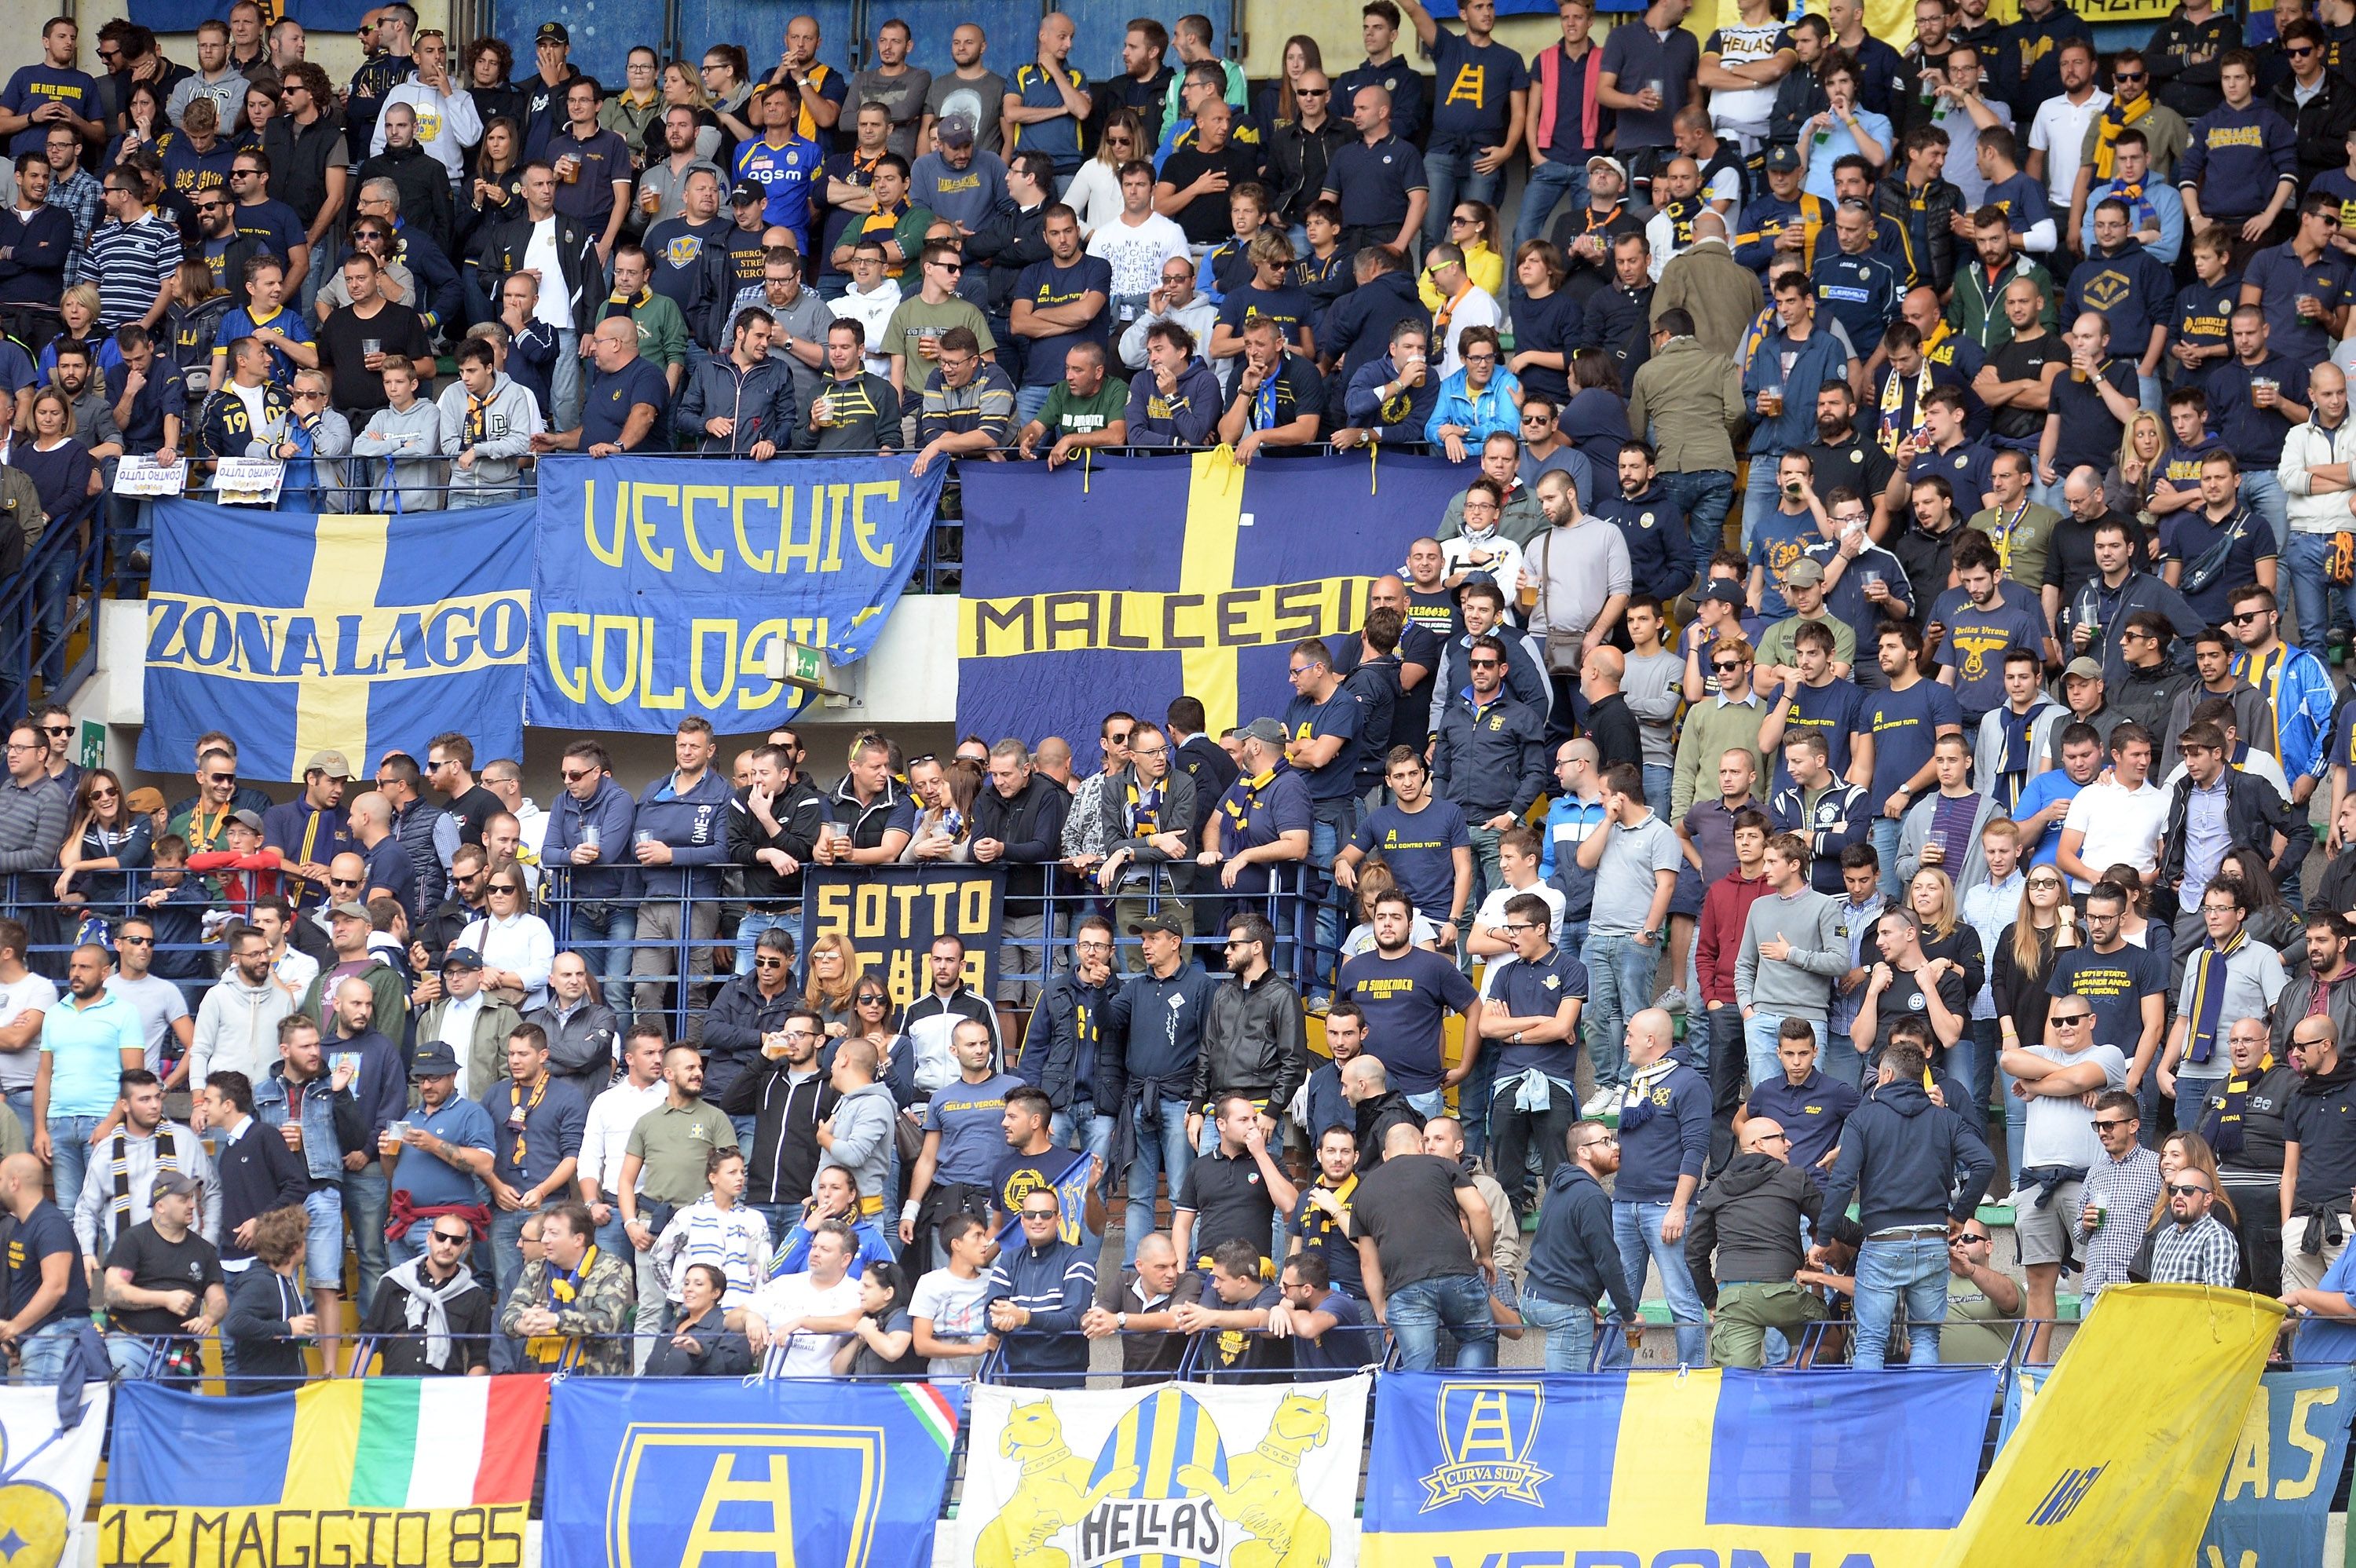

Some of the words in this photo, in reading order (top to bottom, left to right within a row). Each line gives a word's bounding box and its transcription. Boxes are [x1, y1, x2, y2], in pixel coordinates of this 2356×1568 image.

[1722, 35, 1774, 53] HELLAS
[31, 82, 40, 94] WE
[41, 84, 56, 95] HATE
[57, 85, 82, 100] HUMANS
[748, 170, 802, 185] agsm
[223, 415, 248, 435] 19
[119, 470, 146, 481] TUTTO
[148, 470, 181, 481] CONTRO
[219, 467, 245, 477] TUTTO
[248, 467, 279, 479] CONTRO
[584, 478, 900, 575] VECCHIE
[975, 578, 1376, 657] MALCESI
[1408, 606, 1451, 617] LLAGGIO
[1954, 626, 1979, 635] Hellas
[1981, 626, 2009, 637] Verona
[546, 603, 886, 711] GOLOSI
[817, 880, 992, 940] SOTTO
[1356, 980, 1368, 992] NO
[1369, 978, 1413, 992] SURRENDER
[2080, 978, 2108, 987] GRANDE
[2109, 978, 2131, 987] ANNO
[2089, 987, 2119, 996] VERONA
[944, 1102, 971, 1112] HELLAS
[973, 1099, 1006, 1110] VERONA
[1446, 1466, 1491, 1486] CURVA
[1493, 1466, 1523, 1484] SUD
[103, 1509, 177, 1568] 12
[188, 1510, 430, 1568] MAGGIO
[449, 1506, 524, 1568] 85
[1082, 1500, 1220, 1560] HELLAS
